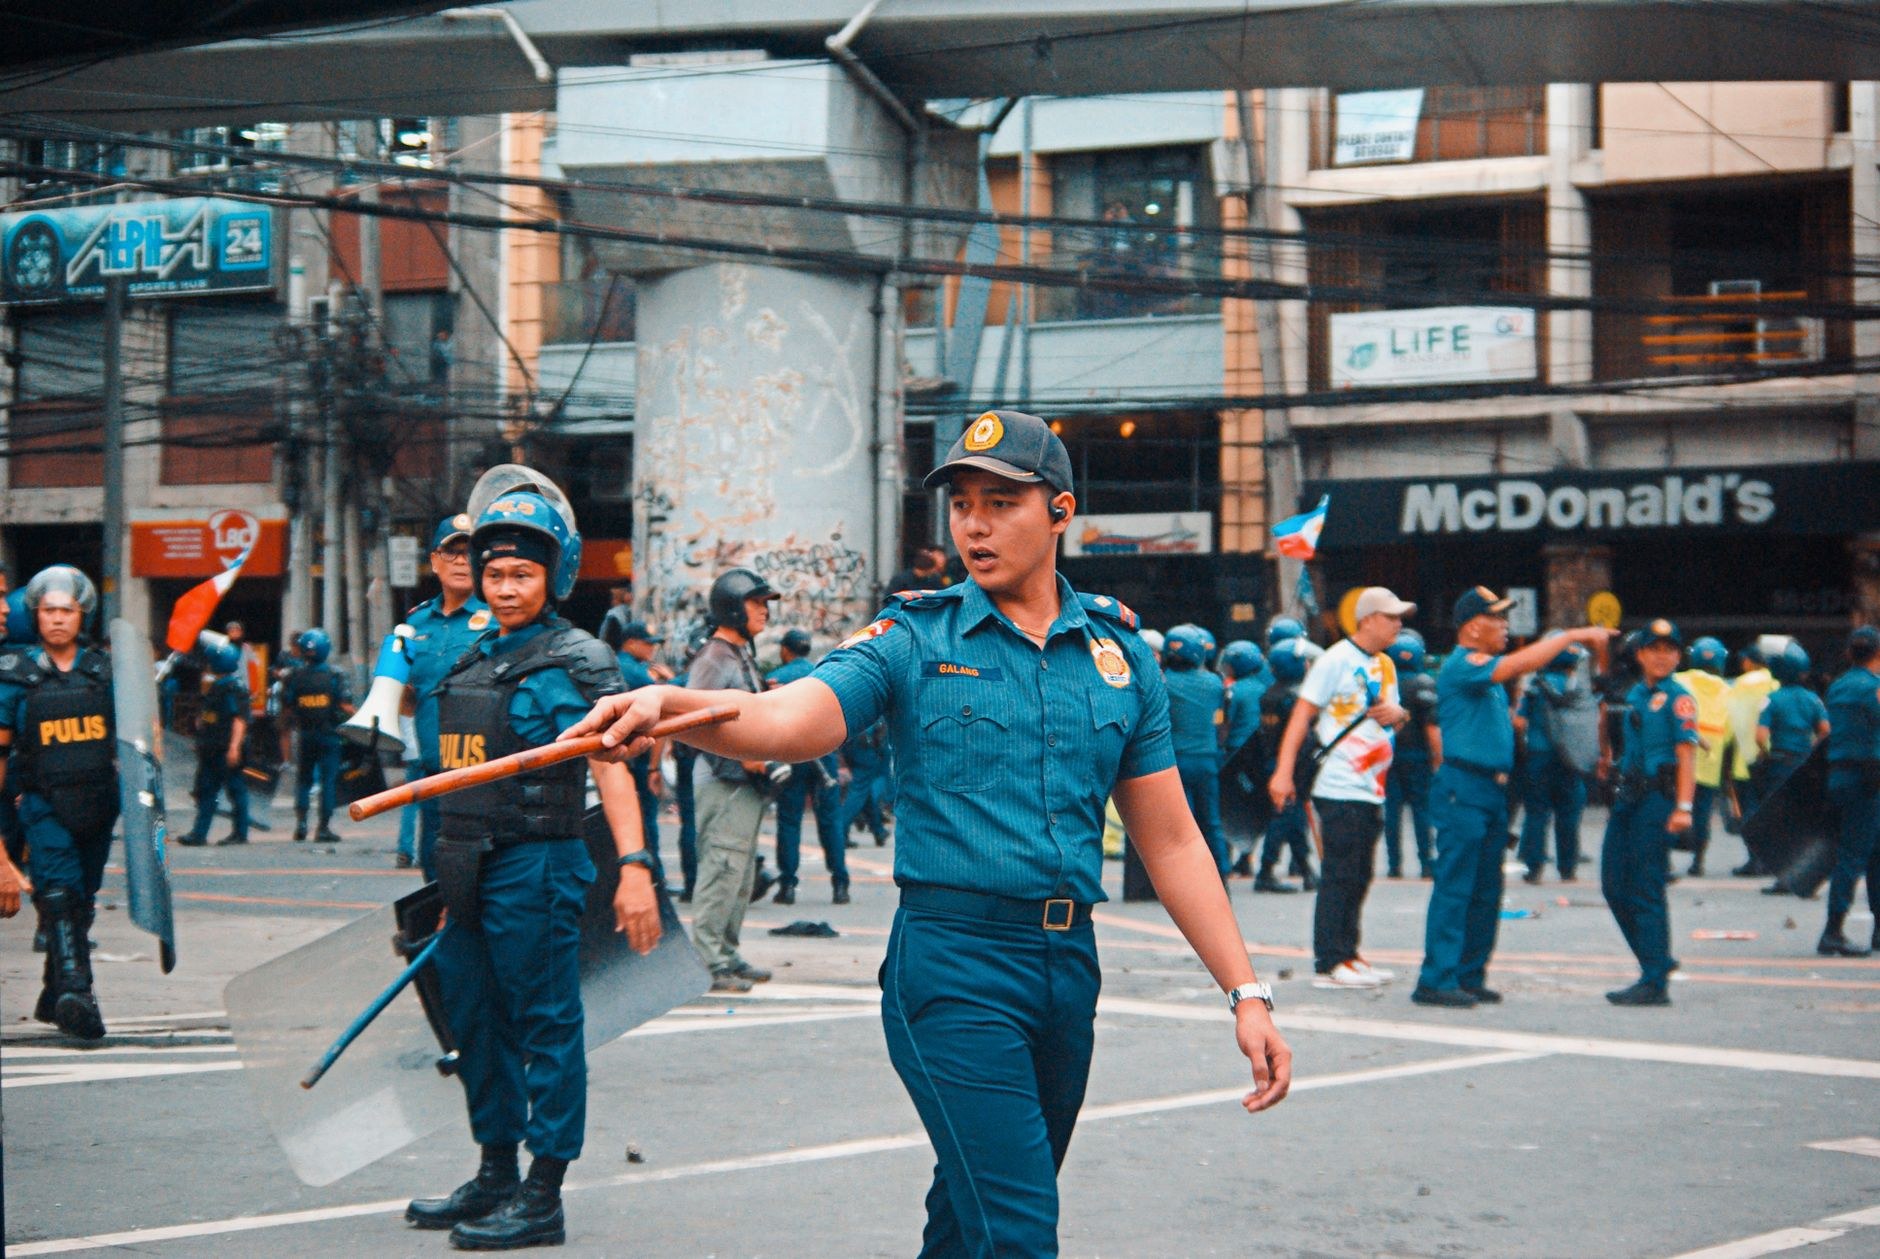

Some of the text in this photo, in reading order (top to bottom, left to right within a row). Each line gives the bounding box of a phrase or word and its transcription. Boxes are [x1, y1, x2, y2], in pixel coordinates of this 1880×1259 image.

[225, 227, 262, 254] 24
[1390, 325, 1471, 354] LIFE
[1401, 474, 1775, 533] McDonald's
[939, 663, 979, 677] GALANG
[40, 714, 107, 746] PULIS
[439, 733, 486, 769] ULIS
